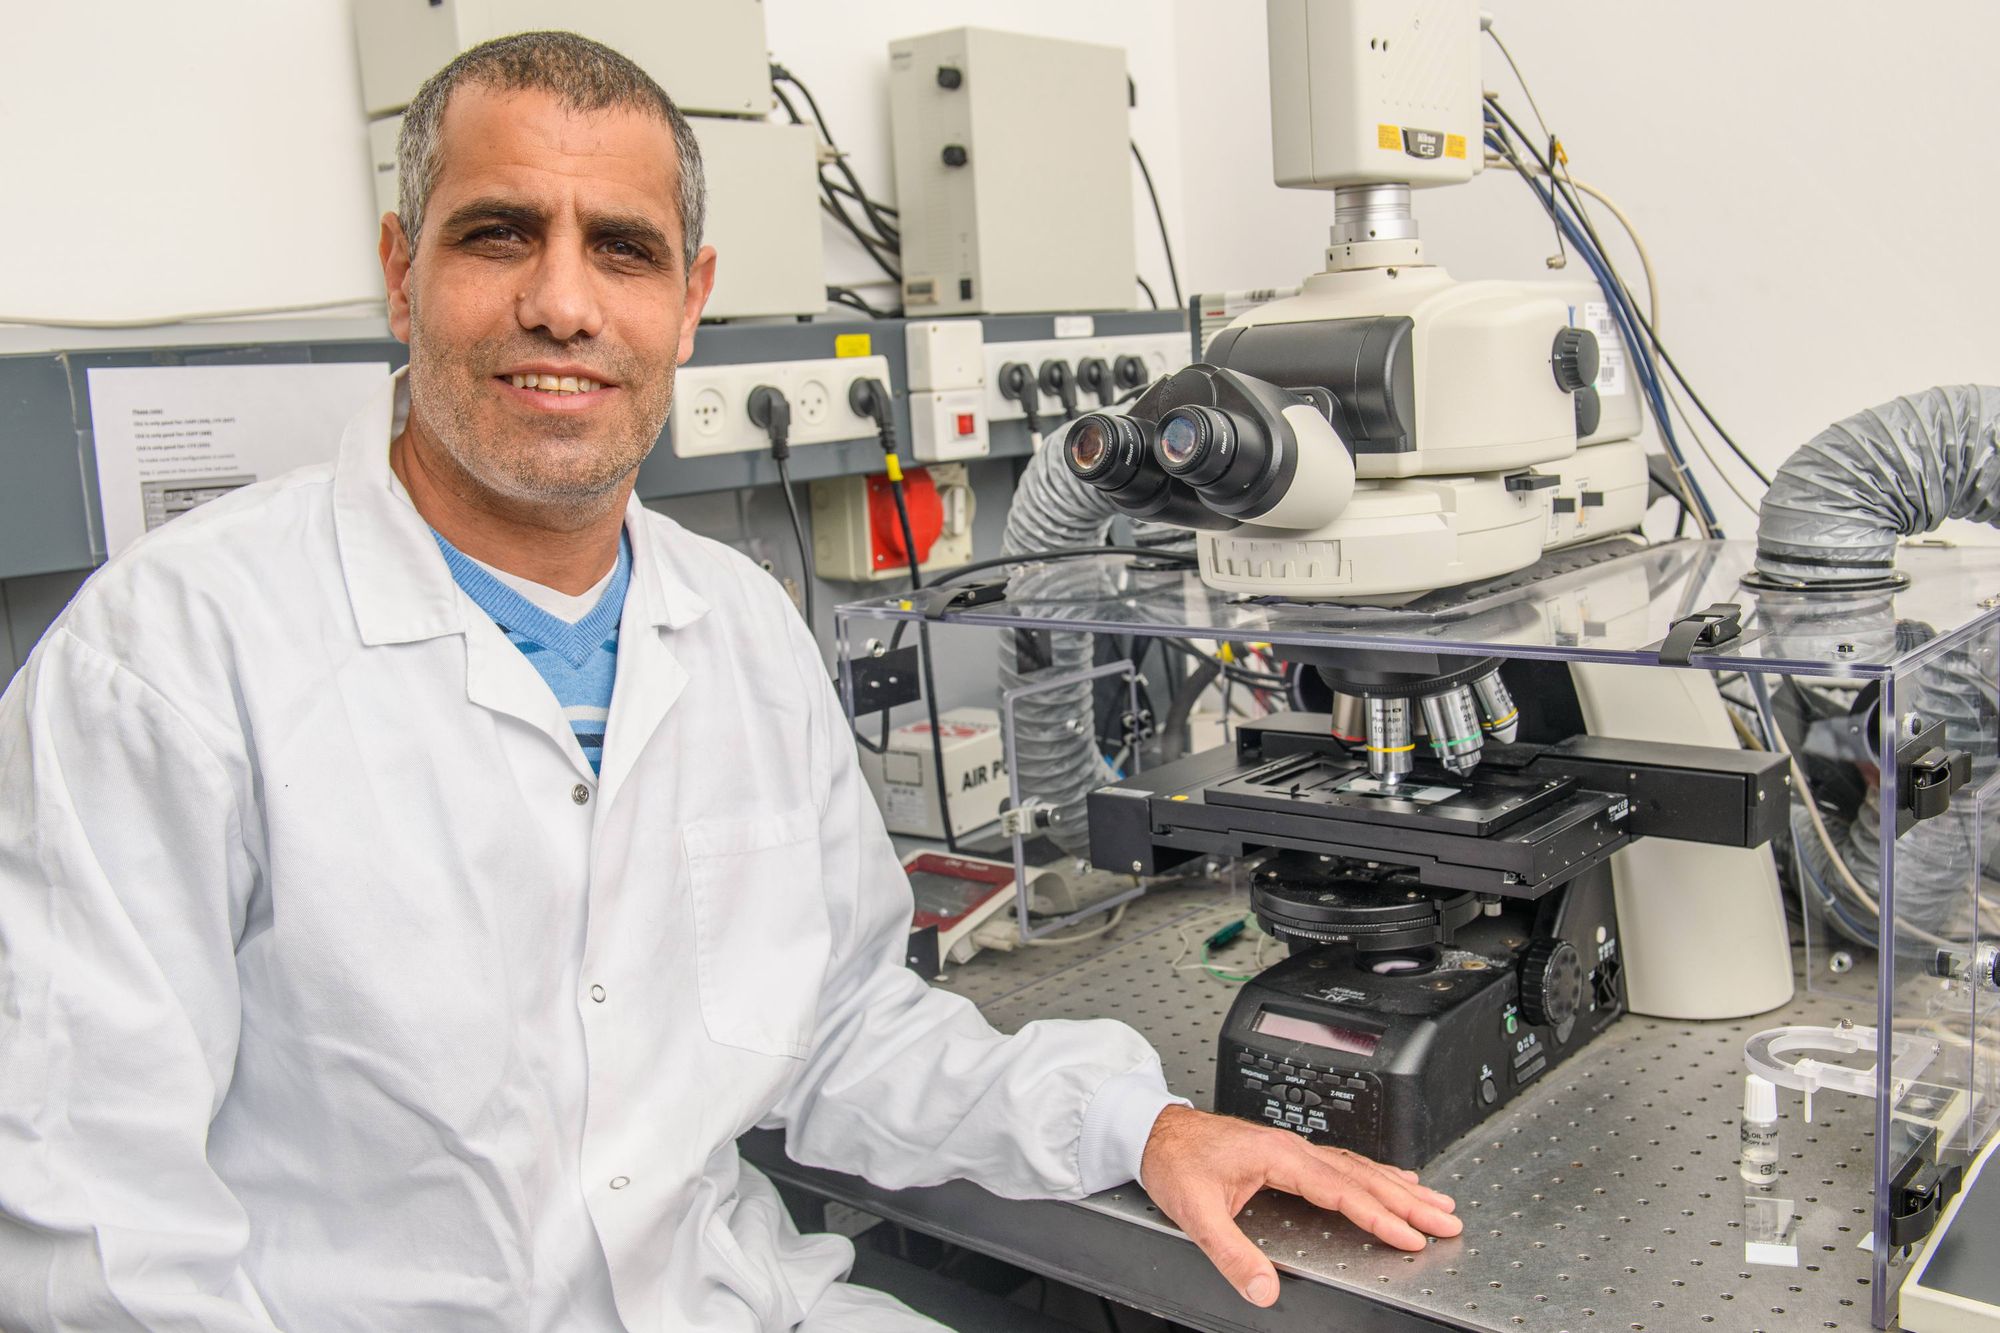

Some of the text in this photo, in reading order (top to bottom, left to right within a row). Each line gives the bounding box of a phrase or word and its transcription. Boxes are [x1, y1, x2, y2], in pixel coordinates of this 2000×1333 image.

[1420, 144, 1435, 155] C2
[1220, 431, 1228, 455] Nikon
[1125, 443, 1134, 466] Nikon
[962, 765, 988, 791] AIR
[1285, 1075, 1307, 1085] DISPLAY
[1330, 1090, 1356, 1100] Z-RESET
[1285, 1104, 1303, 1113] FRONT
[1309, 1109, 1325, 1118] REAR
[1273, 1119, 1292, 1129] POWER
[1296, 1125, 1313, 1134] SLEEP
